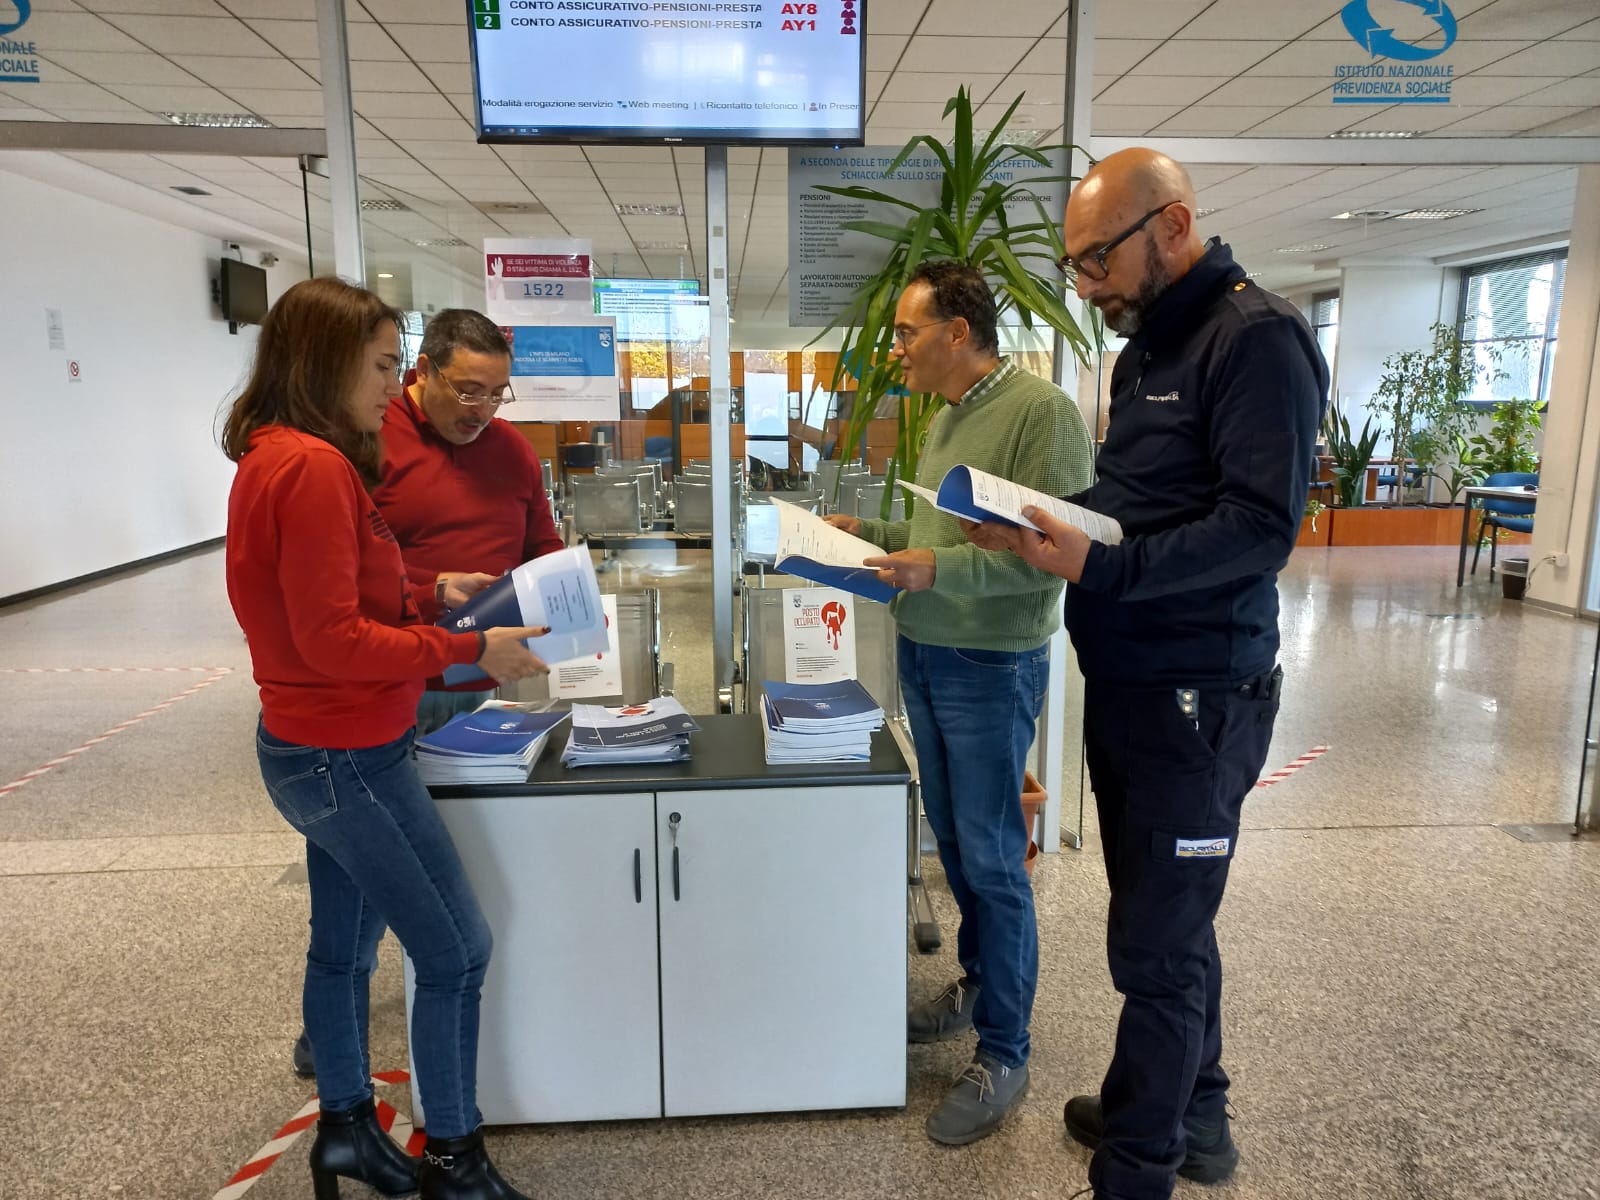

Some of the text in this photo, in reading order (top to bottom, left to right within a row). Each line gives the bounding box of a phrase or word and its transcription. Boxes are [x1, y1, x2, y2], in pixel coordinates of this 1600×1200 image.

[509, 0, 555, 11] CONTO
[780, 3, 818, 15] AY8
[483, 16, 493, 28] 2
[510, 17, 555, 27] CONTO
[780, 19, 816, 31] AY1
[0, 41, 36, 55] NALE
[0, 59, 39, 73] CIALE
[1335, 65, 1454, 78] ISTITUTO NAZIONALE
[1333, 81, 1452, 94] PREVIDENZA SOCIALE
[482, 98, 522, 108] Modalità
[524, 100, 576, 110] erogazione
[578, 100, 614, 109] servizio
[628, 100, 650, 109] Web
[652, 101, 689, 111] meeting
[706, 101, 752, 110] Ricontatto
[754, 102, 798, 110] telefonico
[800, 158, 807, 166] A
[808, 157, 849, 167] SECONDA
[850, 158, 875, 167] DELLE
[877, 158, 921, 168] TIPOOGIE
[922, 159, 933, 168] DI
[1003, 159, 1055, 169] EFFETTUAE
[897, 171, 925, 181] SULLO
[523, 283, 564, 296] 1522
